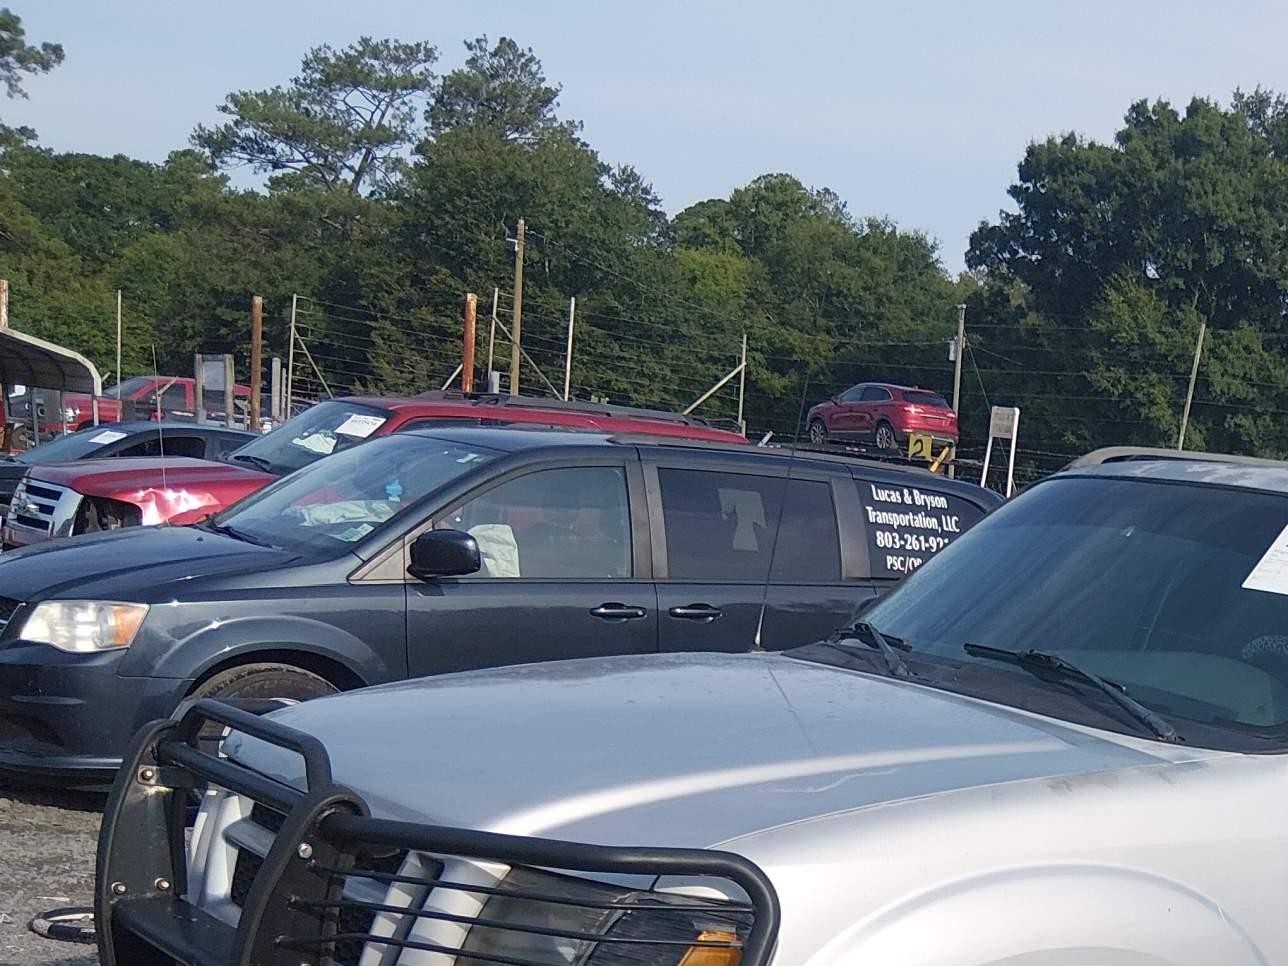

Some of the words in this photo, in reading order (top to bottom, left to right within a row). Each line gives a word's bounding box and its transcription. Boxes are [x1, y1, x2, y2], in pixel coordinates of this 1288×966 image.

[913, 438, 926, 459] 2
[871, 484, 901, 503] Lucas
[903, 488, 912, 504] &
[913, 488, 948, 510] Bryson
[865, 506, 941, 533] Transportation,
[941, 514, 960, 533] LLC
